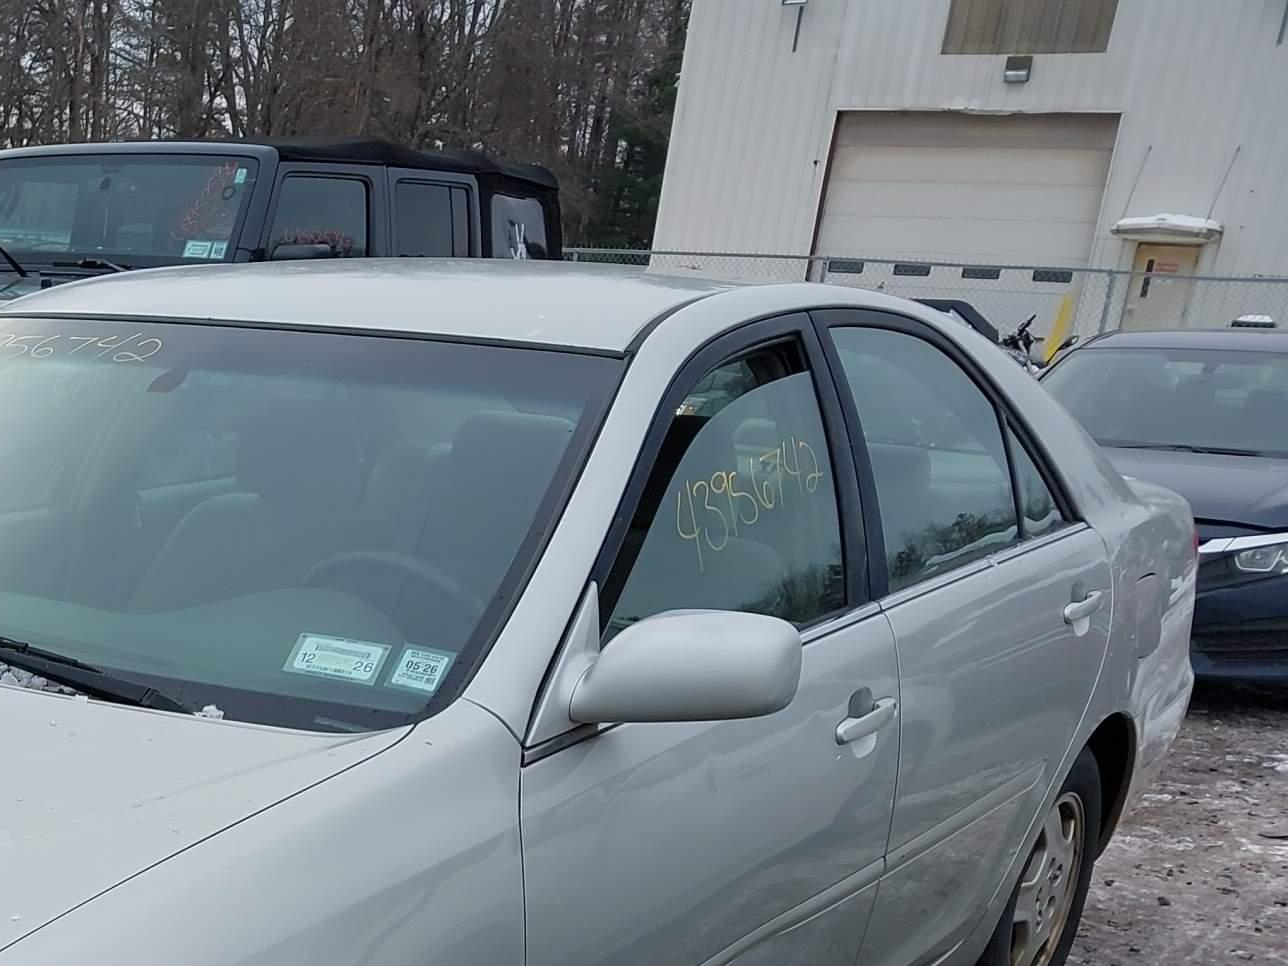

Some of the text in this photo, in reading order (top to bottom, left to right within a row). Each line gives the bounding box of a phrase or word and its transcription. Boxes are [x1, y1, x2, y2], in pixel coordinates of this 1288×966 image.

[676, 436, 824, 573] 43956742
[300, 651, 316, 664] 12
[352, 660, 375, 673] 26
[405, 659, 421, 671] 05
[423, 663, 439, 674] 26
